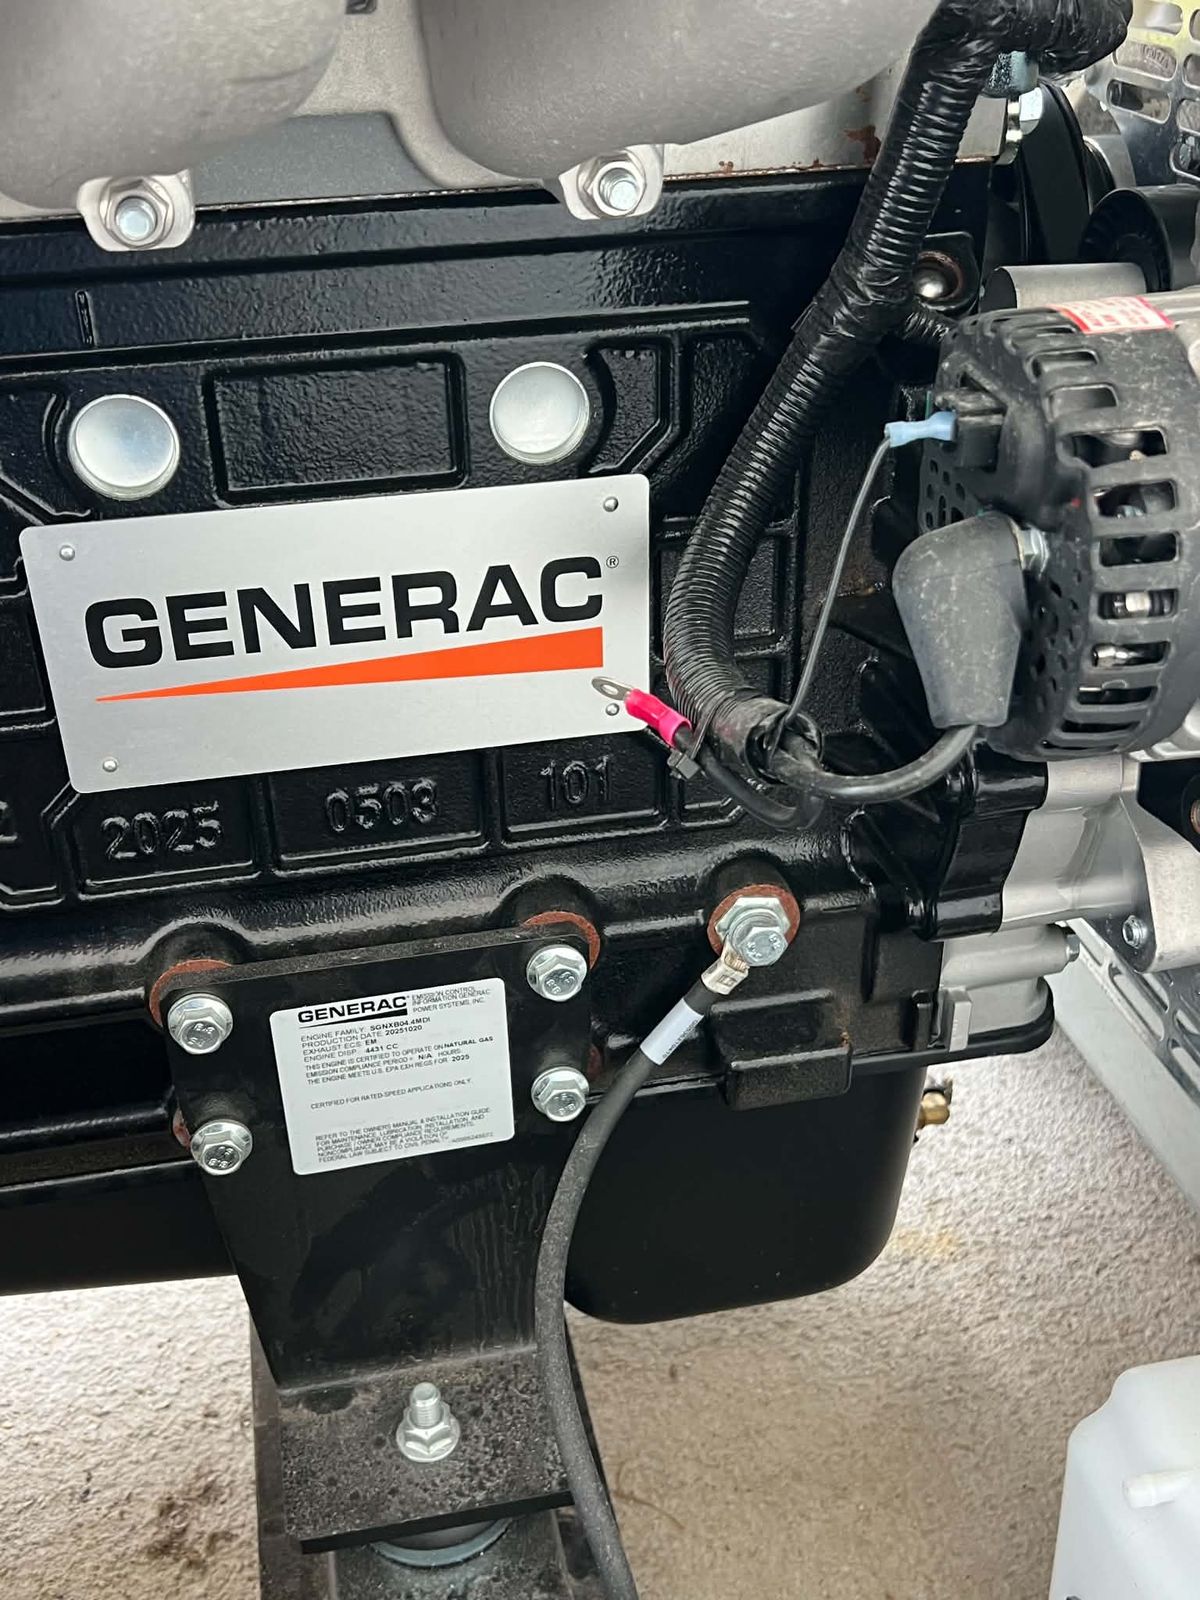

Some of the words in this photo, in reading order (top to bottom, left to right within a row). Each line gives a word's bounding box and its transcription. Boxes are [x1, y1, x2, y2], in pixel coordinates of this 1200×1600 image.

[101, 801, 223, 859] 2025
[412, 1003, 437, 1013] POWER
[300, 1031, 333, 1042] ENGINE
[302, 1035, 358, 1048] PRODUCTION
[385, 1025, 423, 1036] 20251020
[302, 1044, 341, 1055] EXHAUST
[306, 1063, 320, 1071] THIS
[321, 1060, 347, 1070] ENGINE
[356, 1053, 390, 1063] CERTIFIED
[402, 1046, 432, 1055] OPERATE
[444, 1039, 477, 1048] NATURAL
[303, 1052, 336, 1062] ENGINE
[322, 1074, 347, 1084] ENGINE
[434, 1057, 447, 1065] FOR
[340, 1061, 380, 1073] COMPLIANCE
[310, 1098, 345, 1109] CERTIFIED
[345, 1095, 360, 1103] FOR
[407, 1081, 453, 1094] APPLICATIONS
[425, 1111, 470, 1123] INSTALLATION
